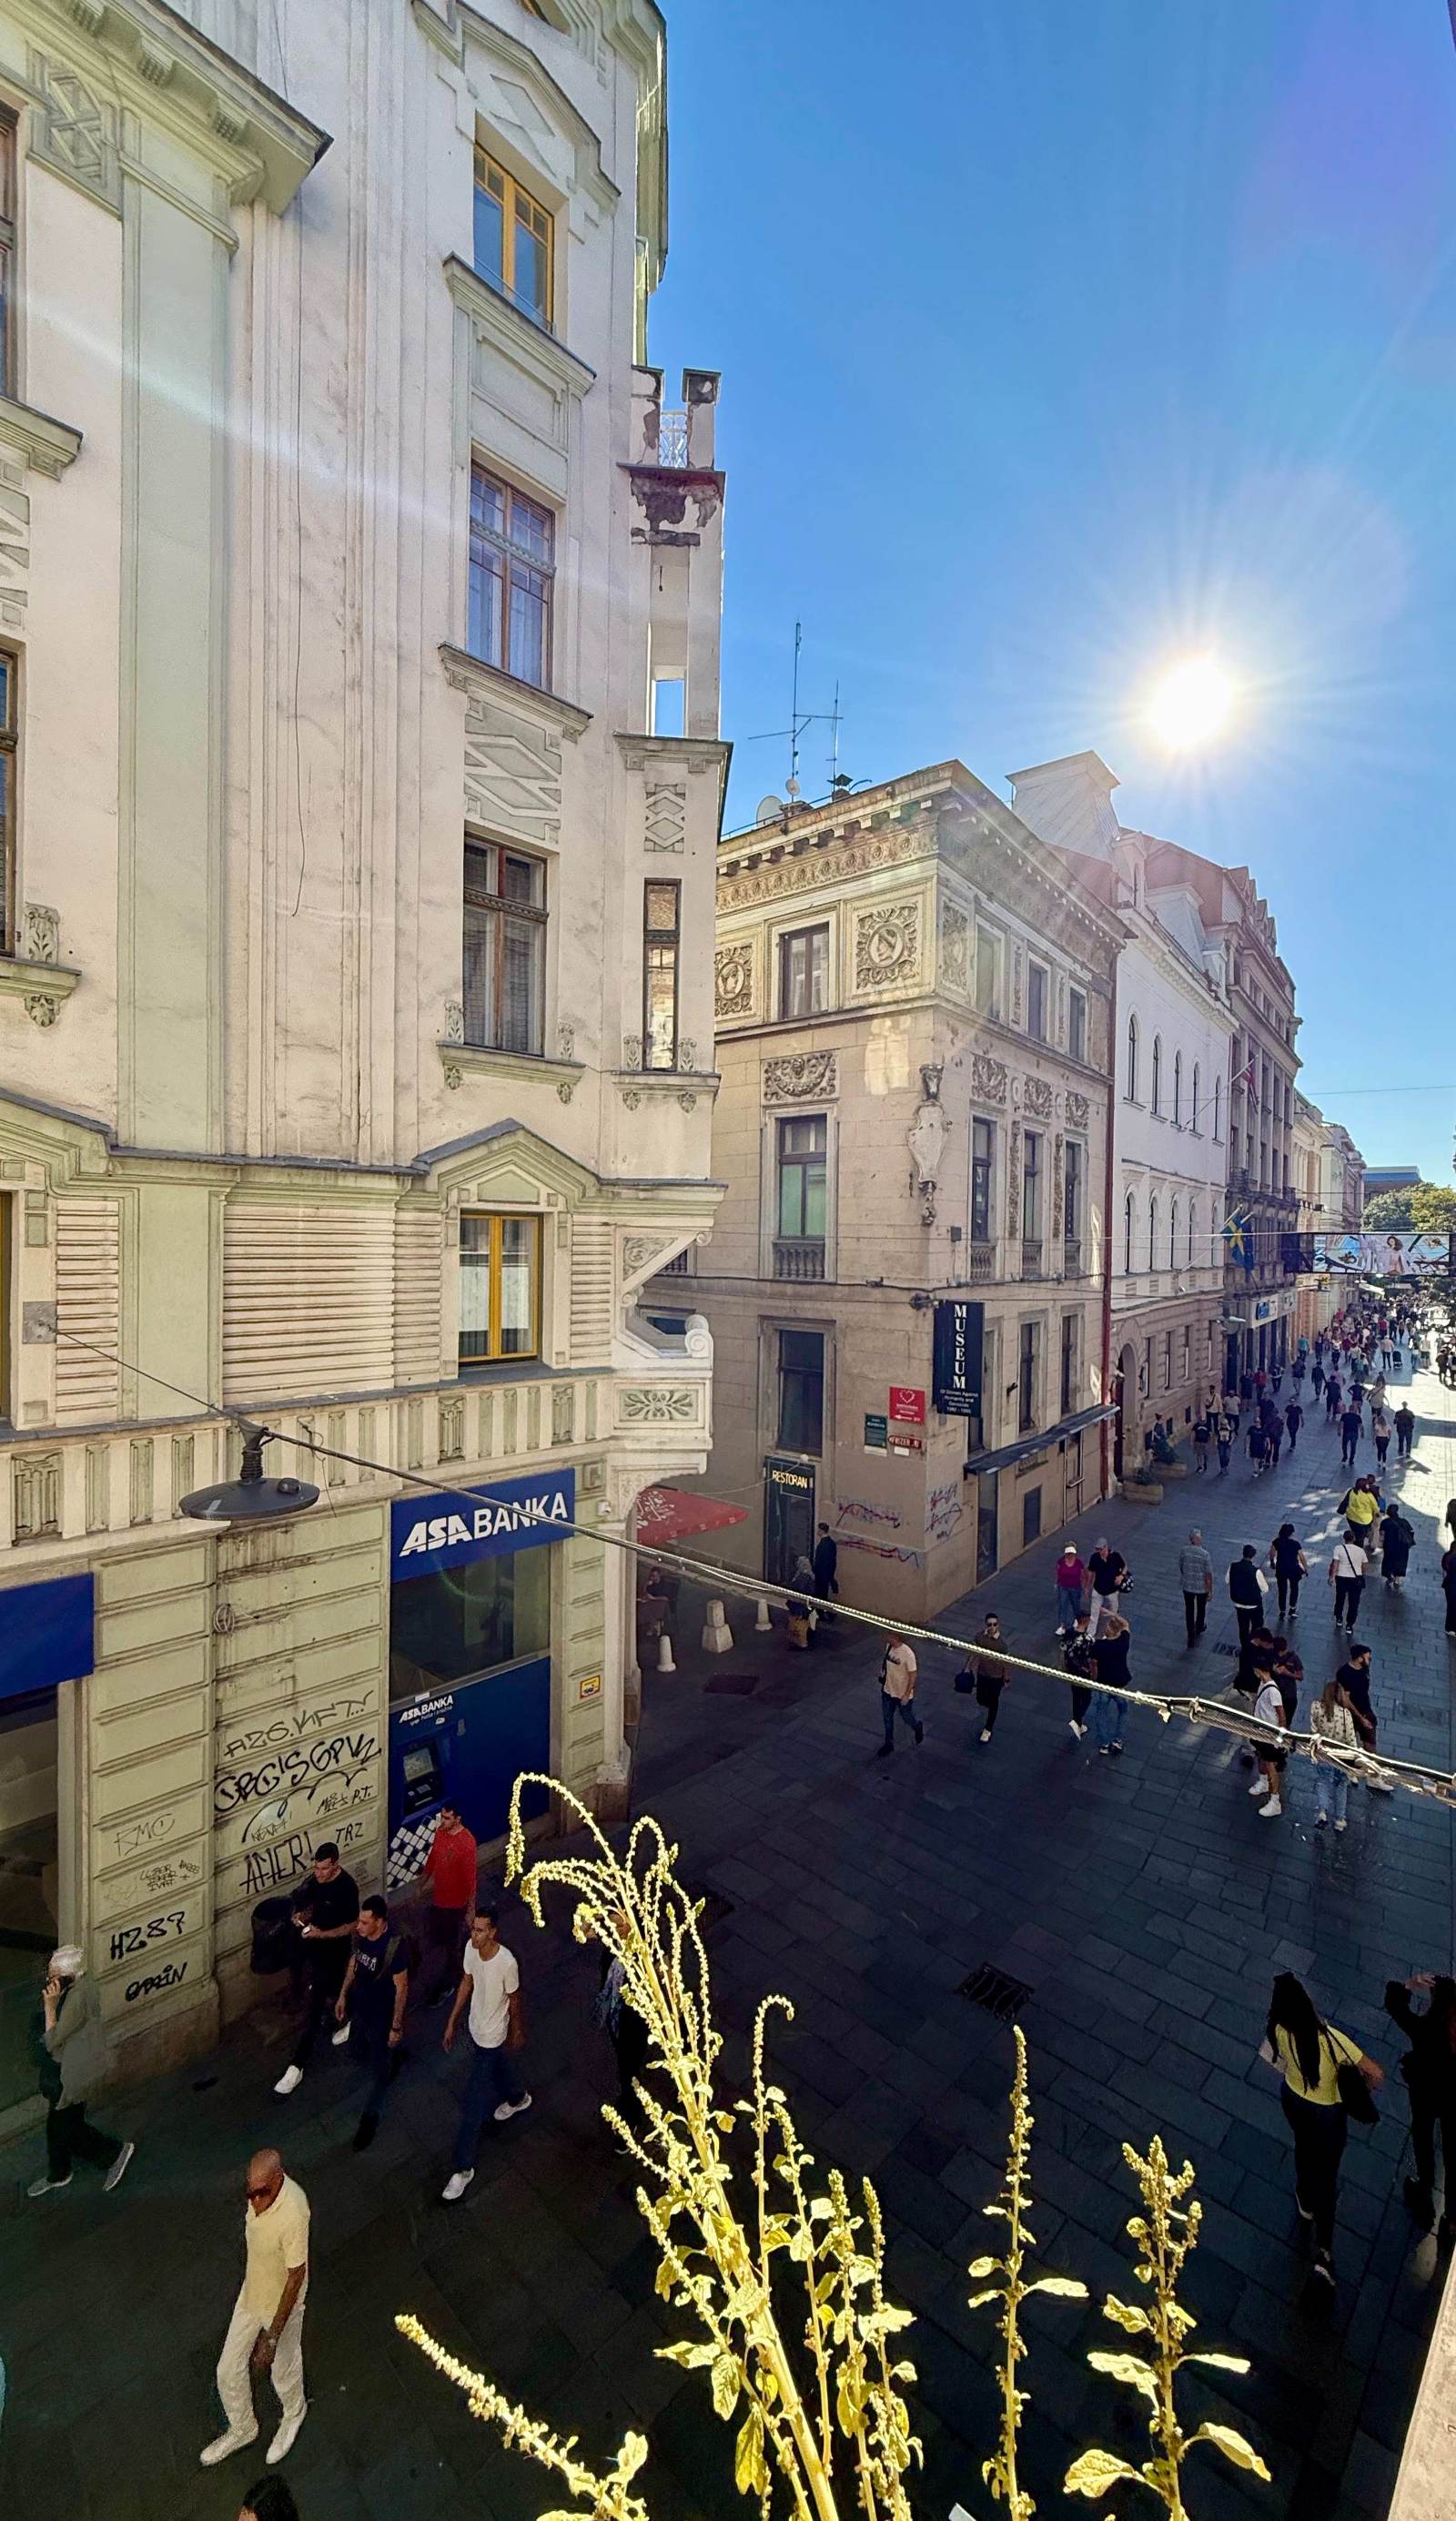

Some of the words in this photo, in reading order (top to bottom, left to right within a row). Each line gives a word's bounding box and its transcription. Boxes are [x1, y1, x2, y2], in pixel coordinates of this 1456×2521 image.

[954, 1304, 967, 1389] MUSEUM
[772, 1471, 808, 1489] RESTORAN
[399, 1514, 473, 1557] ASA
[473, 1492, 569, 1539] BANKA
[421, 1695, 453, 1715] BANKA
